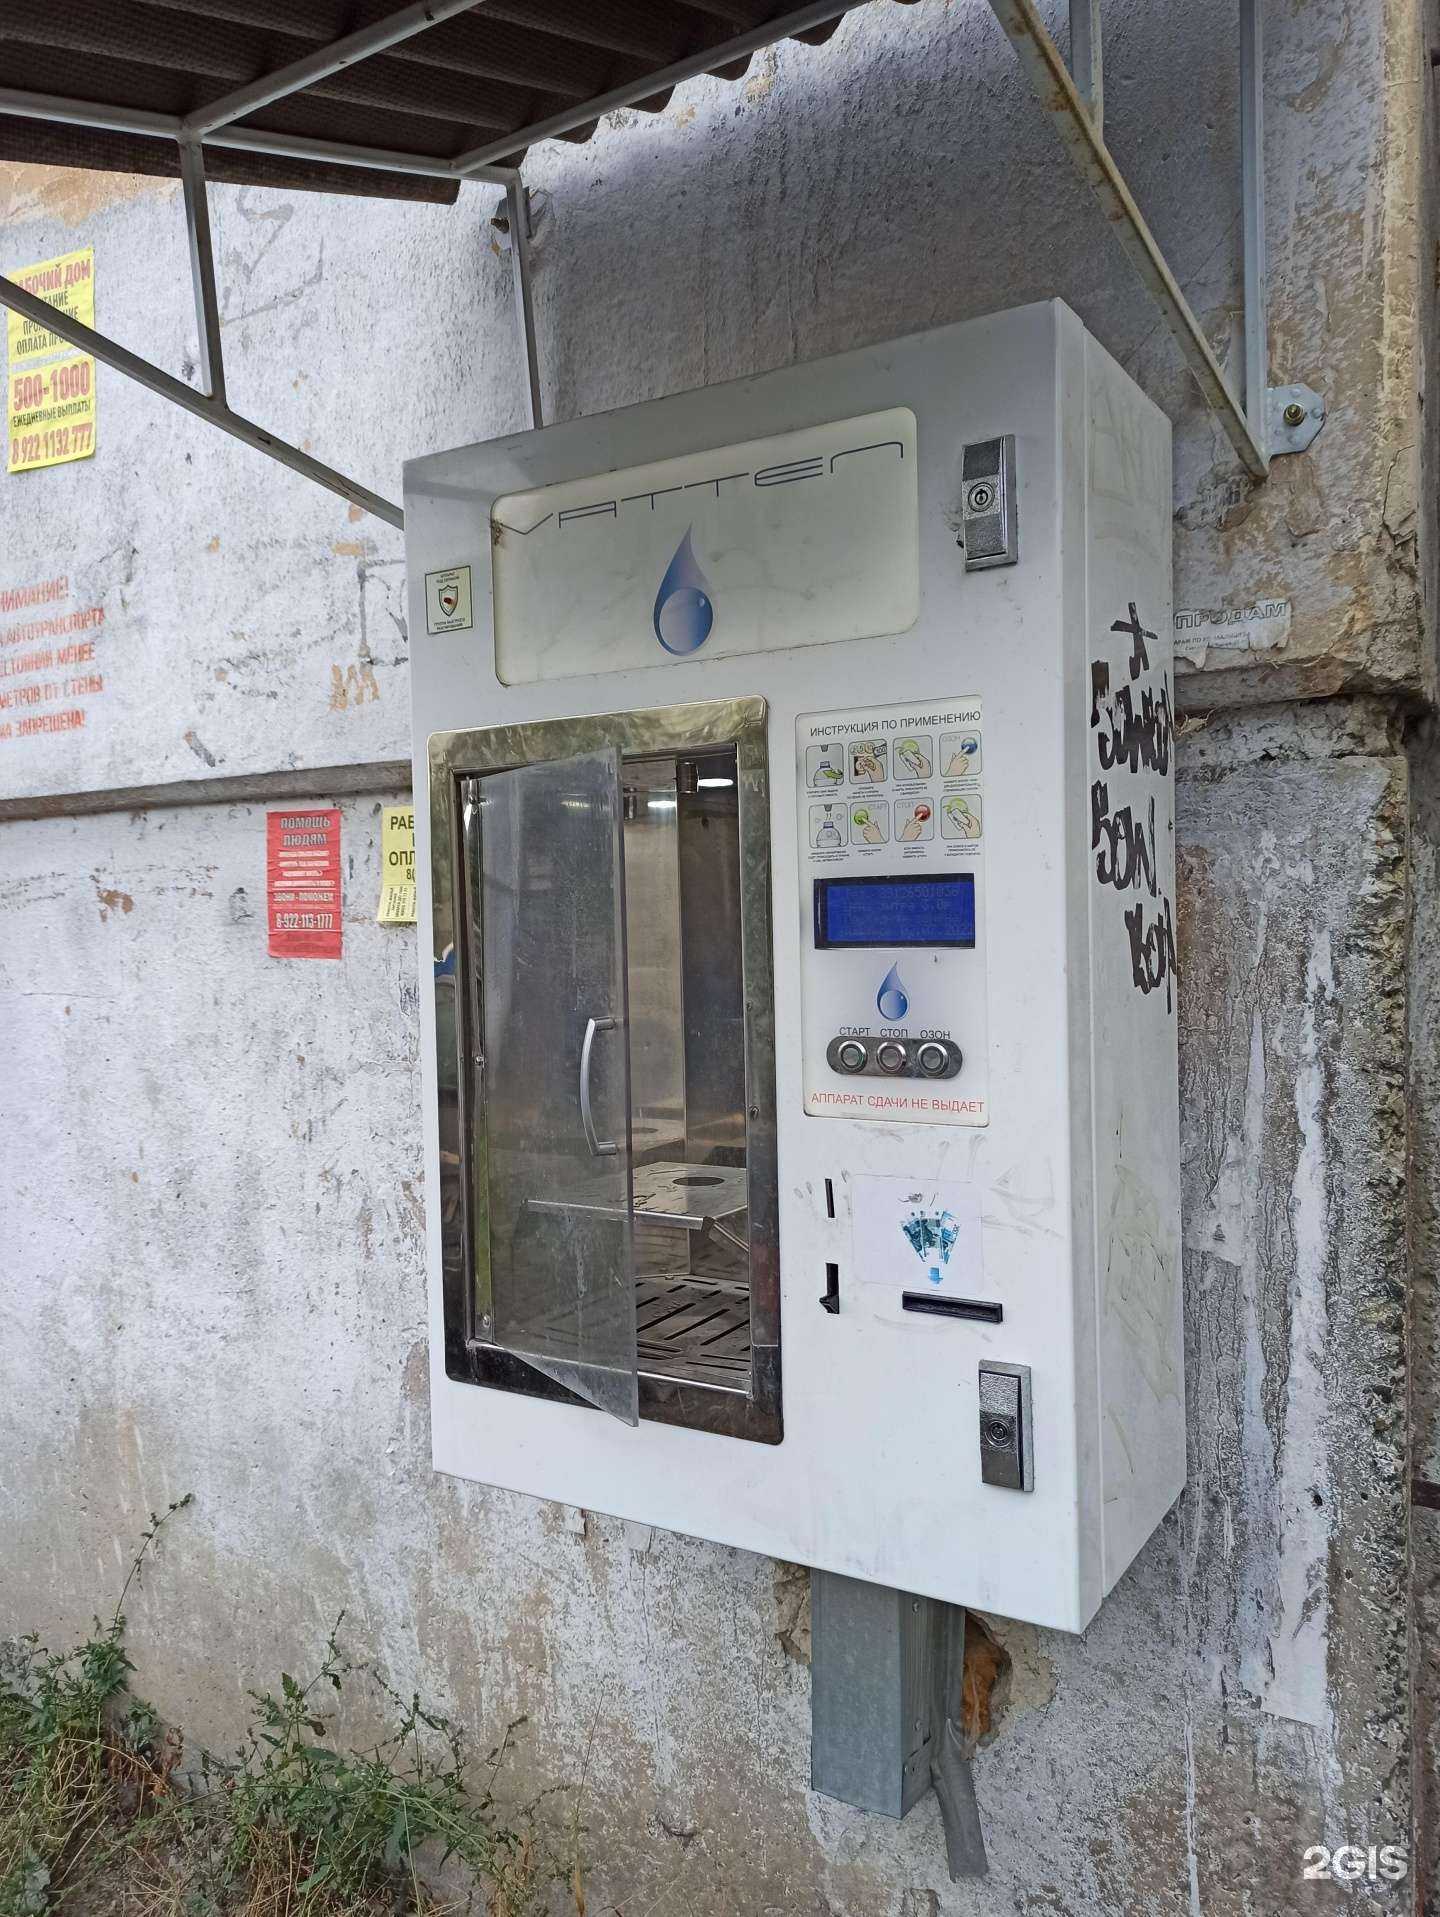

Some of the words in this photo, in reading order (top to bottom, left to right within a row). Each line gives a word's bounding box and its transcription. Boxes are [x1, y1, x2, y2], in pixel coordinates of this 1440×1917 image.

[16, 263, 62, 294] БОЧИЙ
[64, 259, 91, 289] ДОМ
[17, 335, 47, 355] ОПЛАТА
[14, 361, 90, 411] 500-1000
[13, 407, 56, 427] ЕЖЕДНЕВНЫЕ
[57, 400, 91, 418] ВЫПЛАТЫ
[12, 438, 20, 465] 8
[21, 434, 40, 463] 922
[43, 427, 70, 459] 1132
[72, 422, 93, 453] 777
[1176, 602, 1287, 630] ПРОДАМ
[810, 722, 879, 737] ИНСТРУКЦИЯ
[881, 720, 897, 730] ПО
[900, 711, 981, 729] ПРИМЕНЕНИЮ
[280, 816, 330, 829] ПОМОЩЬ
[283, 834, 327, 847] ЛЮДЯМ
[839, 1027, 871, 1037] СТАРТ
[880, 1028, 908, 1038] СТОП
[920, 1030, 951, 1040] ОЗОН
[811, 1092, 863, 1105] АППАРАТ
[867, 1095, 908, 1109] СДАЧИ
[911, 1097, 928, 1110] НЕ
[931, 1099, 985, 1113] ВЫДАЕТ
